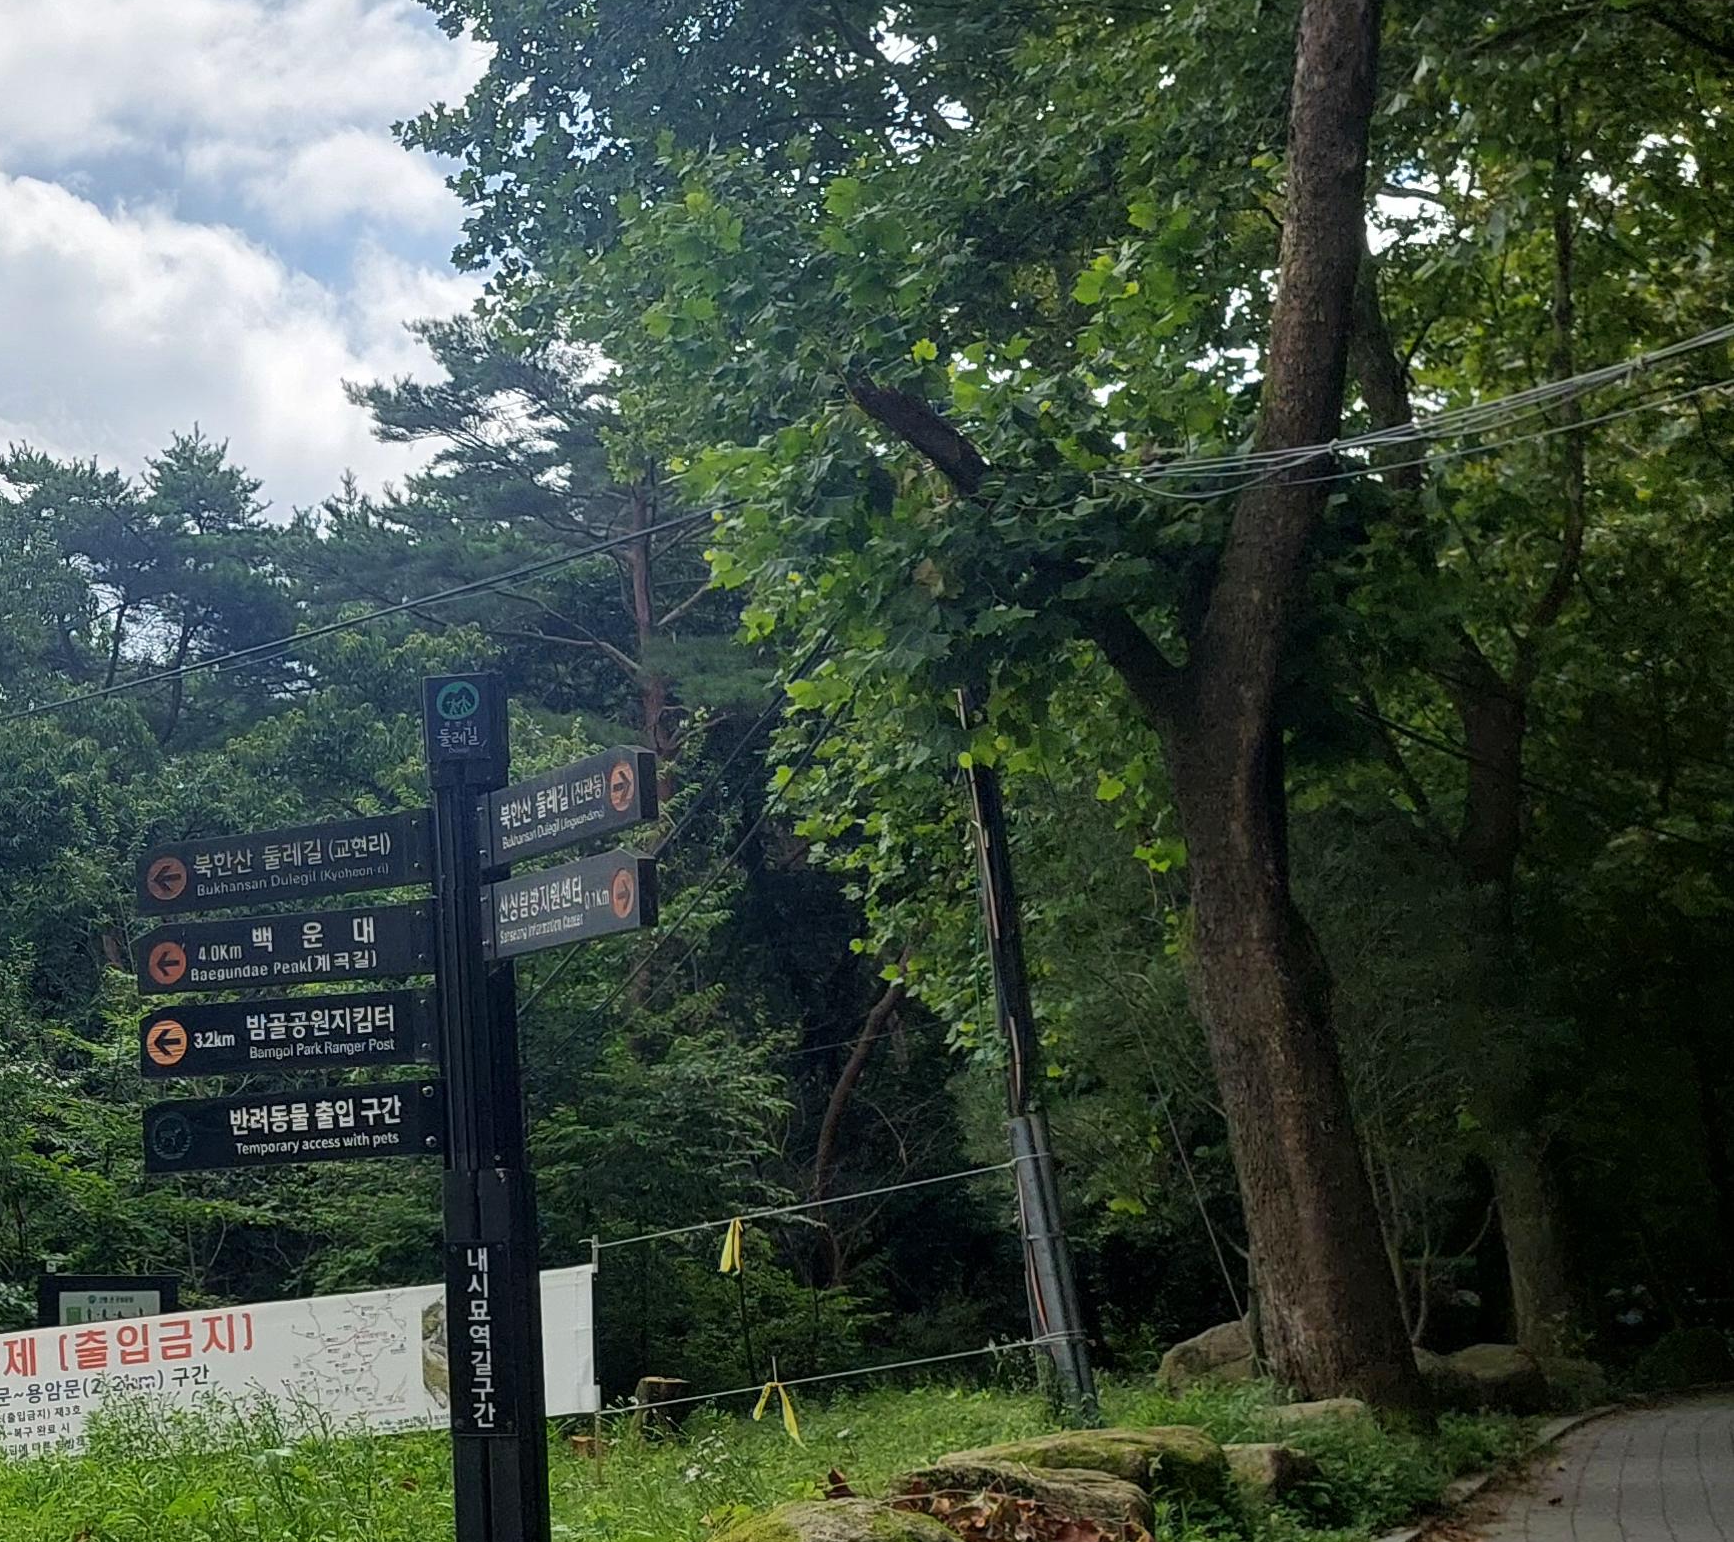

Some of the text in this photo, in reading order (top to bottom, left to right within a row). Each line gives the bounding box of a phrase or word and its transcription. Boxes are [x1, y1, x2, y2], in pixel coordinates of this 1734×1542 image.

[437, 726, 480, 748] 둘레길
[500, 770, 606, 830] 북한산 둘레길 (진관동)
[193, 832, 391, 878] 북한산 둘레길 (교현리)
[197, 877, 266, 897] Bukhansan
[271, 869, 316, 888] Dulegil
[499, 875, 582, 924] 산성탐방지원센터
[198, 945, 242, 962] 4.0Km
[190, 965, 268, 983] Baegundae
[193, 1004, 396, 1049] 3.2km 밤골공원지킴터
[249, 1036, 396, 1060] Bamgol Park Ranger Post
[229, 1094, 403, 1136] 반려동물 출입 구간
[235, 1130, 400, 1157] Temporary access with pets
[466, 1247, 496, 1429] 내시묘역길구간
[171, 1364, 209, 1387] 구간
[60, 1422, 71, 1434] 시
